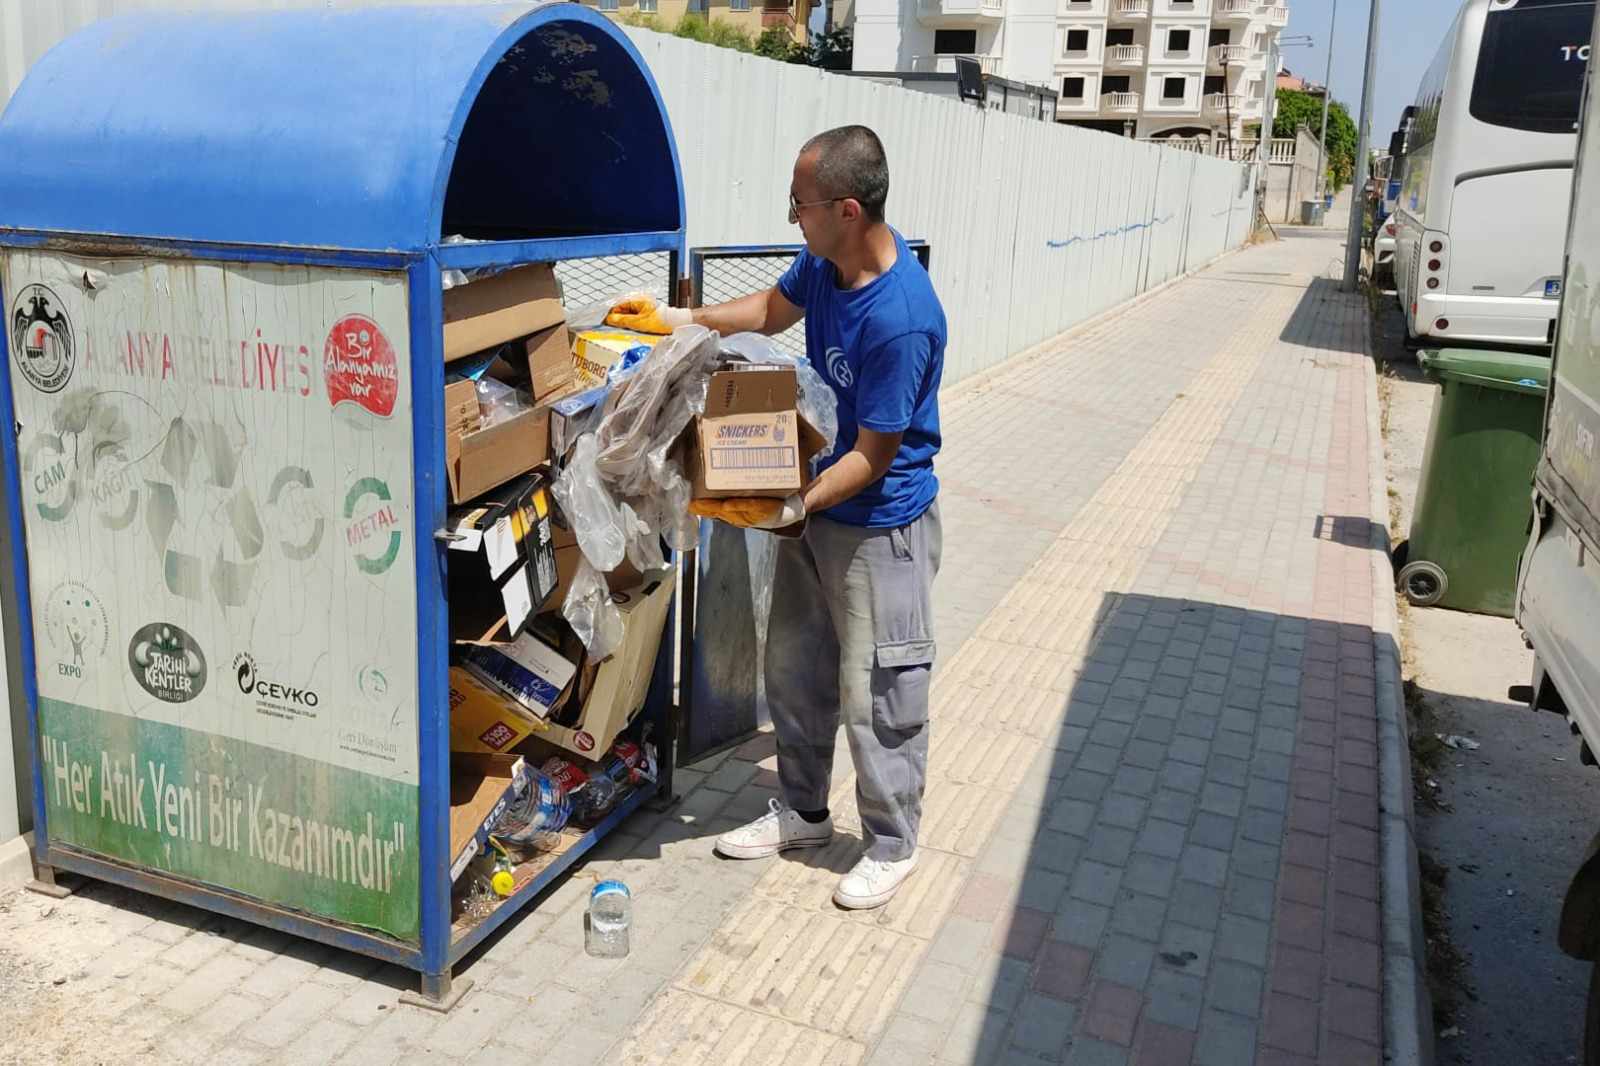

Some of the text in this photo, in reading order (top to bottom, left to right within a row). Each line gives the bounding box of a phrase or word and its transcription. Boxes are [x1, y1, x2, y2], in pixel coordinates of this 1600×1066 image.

[571, 351, 607, 378] TUBORG
[716, 424, 768, 439] SNICKERS
[34, 461, 66, 494] CAM
[346, 505, 399, 546] METAL
[58, 663, 82, 679] EXPO
[144, 667, 192, 693] KENTLER
[256, 681, 318, 707] ÇEVKO
[43, 735, 93, 815] "Her
[101, 751, 148, 830] Atık
[149, 759, 203, 843] Yeni
[208, 774, 242, 851] Bir
